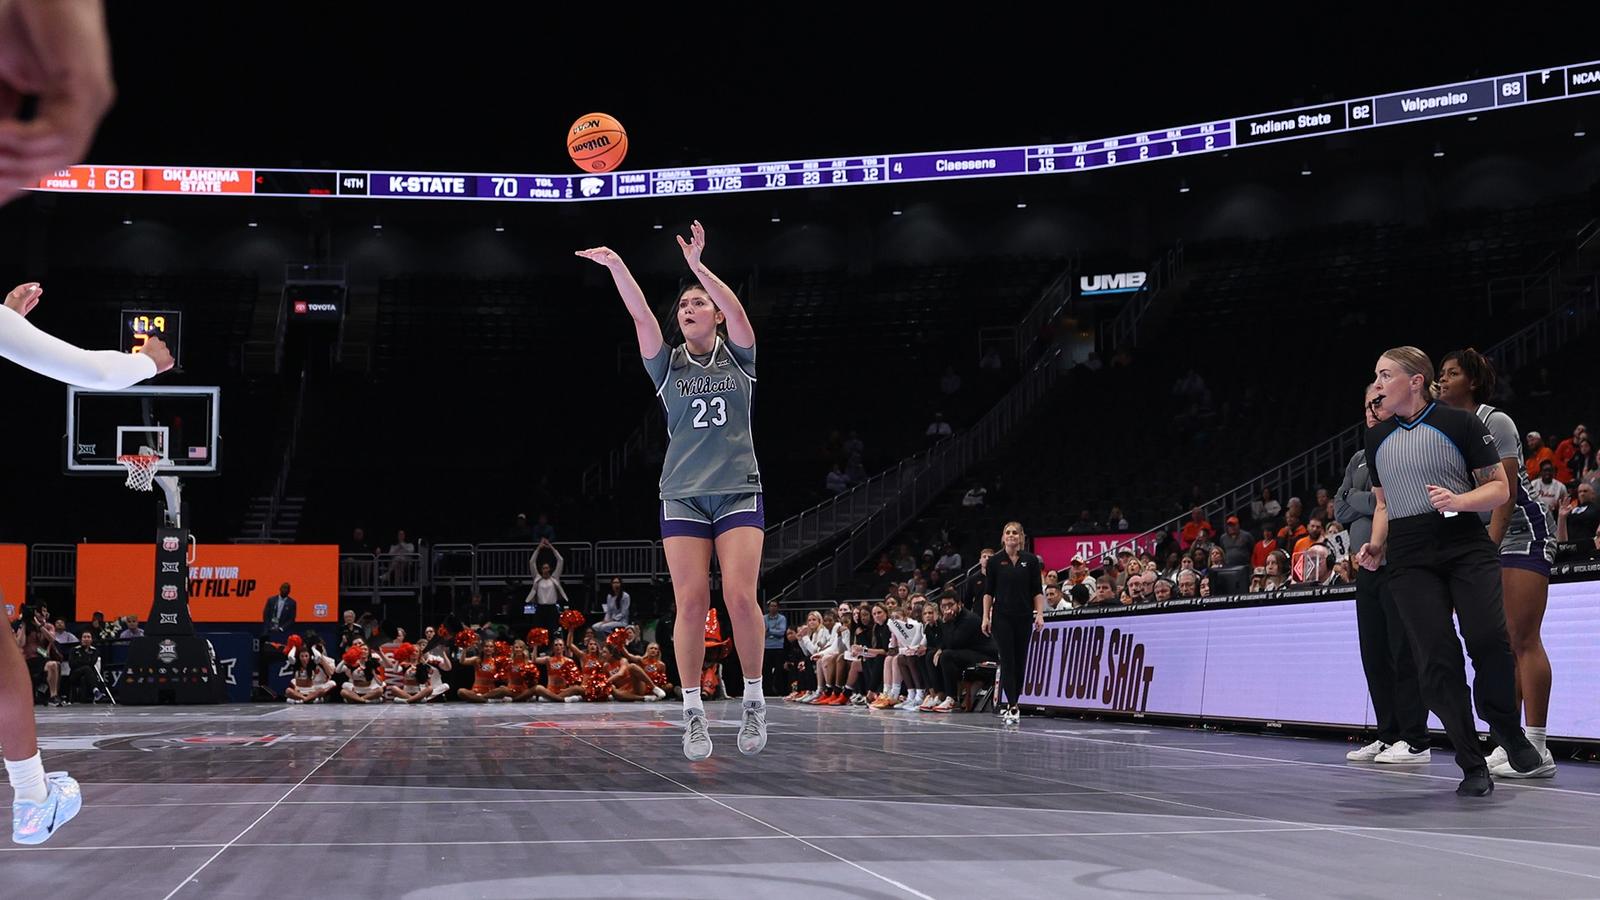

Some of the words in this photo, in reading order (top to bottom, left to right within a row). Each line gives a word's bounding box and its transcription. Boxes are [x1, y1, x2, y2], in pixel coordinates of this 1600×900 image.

[1542, 71, 1550, 84] F
[1502, 82, 1521, 97] 63
[1401, 92, 1468, 113] Valparaiso
[1352, 105, 1370, 120] 62
[1250, 119, 1295, 136] Indiana
[1298, 113, 1331, 128] State
[572, 135, 611, 153] Wilson
[1171, 141, 1179, 154] 1
[1205, 136, 1214, 149] 2
[1107, 151, 1116, 164] 5
[1140, 146, 1149, 159] 2
[894, 162, 903, 174] 4
[936, 157, 996, 173] Claessens
[1038, 158, 1055, 171] 15
[1075, 155, 1085, 168] 4
[89, 168, 95, 178] 1
[105, 169, 135, 189] 68
[163, 169, 240, 182] OKLAHOMA
[620, 175, 645, 184] TEAM
[803, 172, 820, 185] 23
[832, 170, 848, 183] 21
[863, 168, 878, 181] 12
[88, 179, 96, 189] 4
[180, 181, 222, 192] STATE
[344, 178, 364, 189] 4TH
[389, 177, 465, 194] K-STATE
[491, 177, 518, 197] 70
[566, 178, 573, 188] 1
[707, 177, 742, 191] 11/25
[765, 174, 786, 187] 1/3
[530, 188, 560, 199] FOULS
[565, 188, 573, 199] 2
[619, 184, 645, 194] STATS
[1080, 272, 1147, 291] UMB
[676, 375, 737, 396] Wildcats
[692, 397, 727, 428] 23
[200, 567, 213, 579] ON
[215, 566, 239, 579] YOUR
[205, 580, 256, 597] FILL-UP
[1021, 628, 1059, 698] OOT
[1057, 626, 1105, 699] YOUR
[1102, 628, 1154, 712] SHOT
